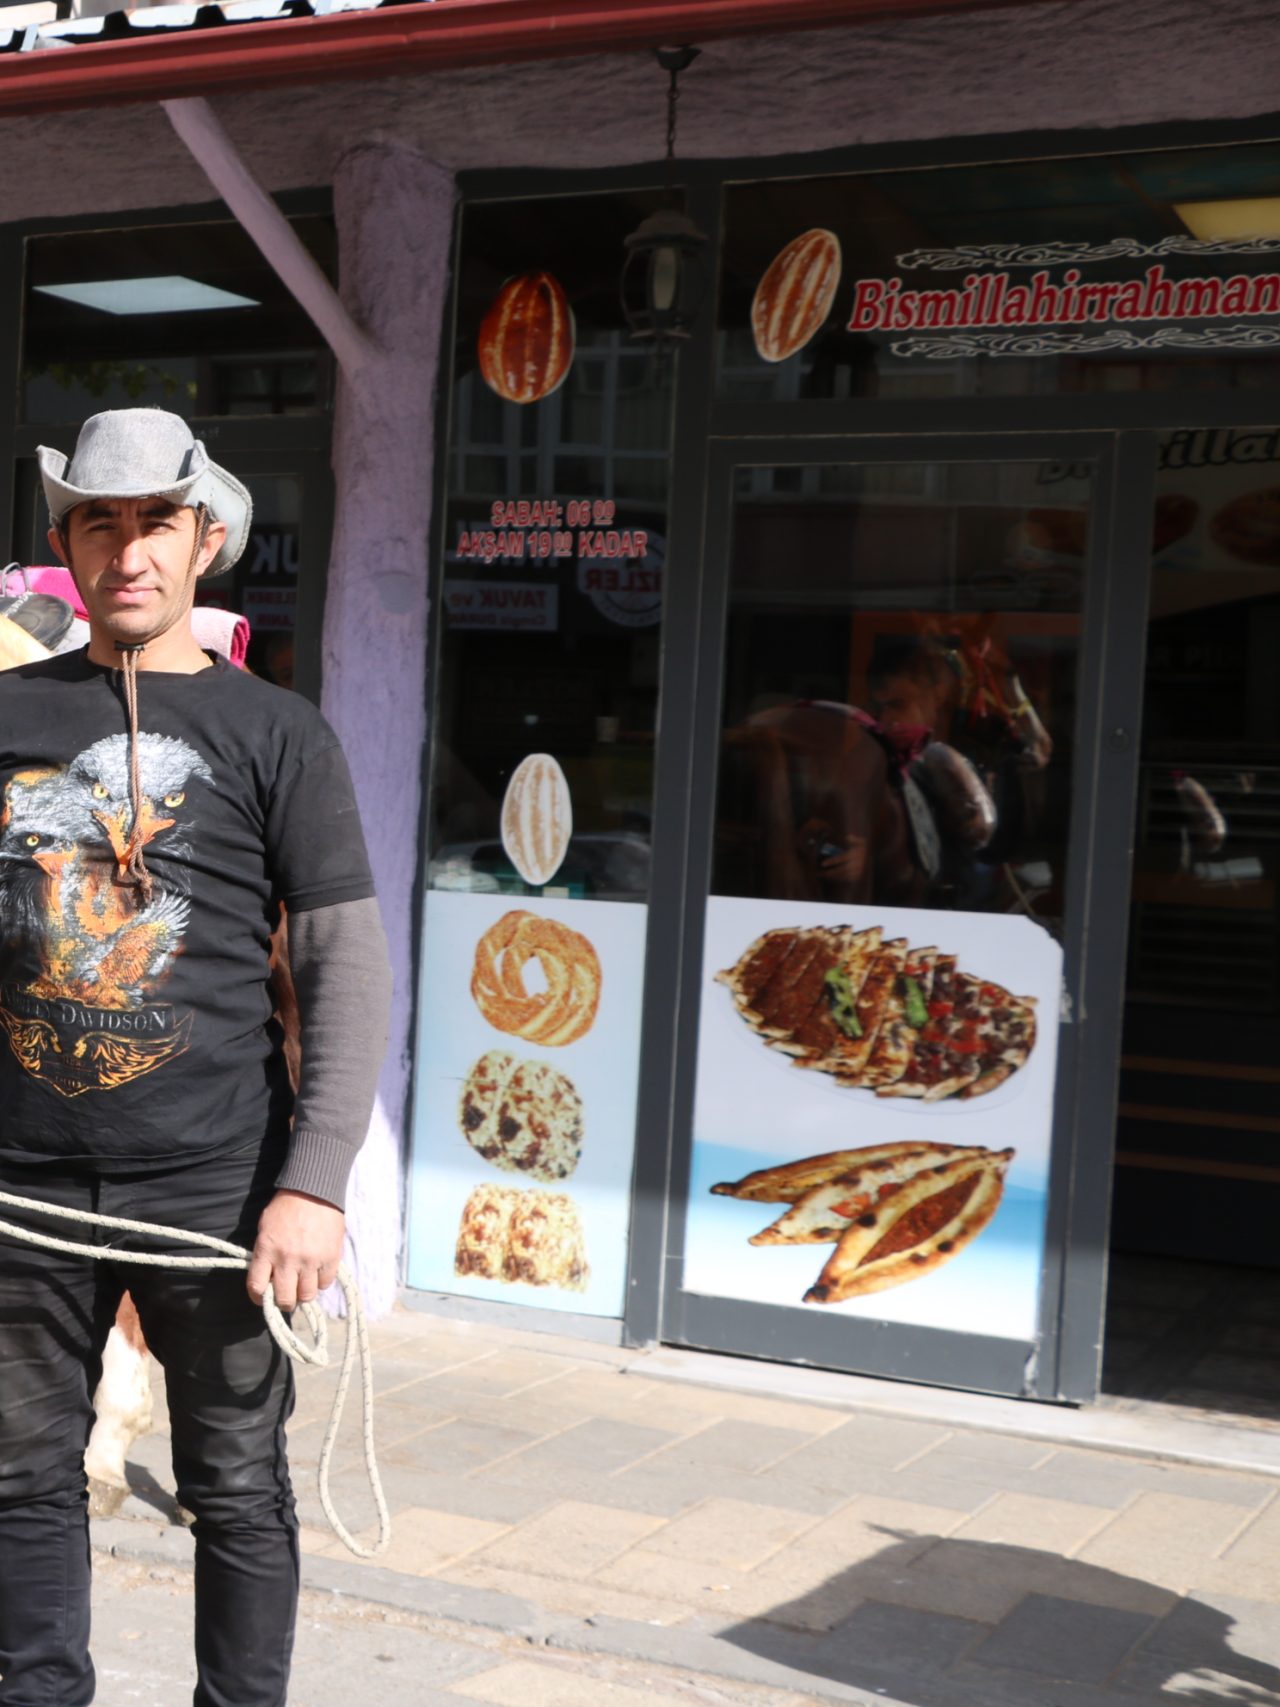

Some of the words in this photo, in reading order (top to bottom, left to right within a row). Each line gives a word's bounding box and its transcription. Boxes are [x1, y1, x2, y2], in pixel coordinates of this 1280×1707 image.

[491, 499, 564, 528] SABAH:
[456, 530, 525, 564] AKŞAM
[577, 530, 649, 558] KADAR
